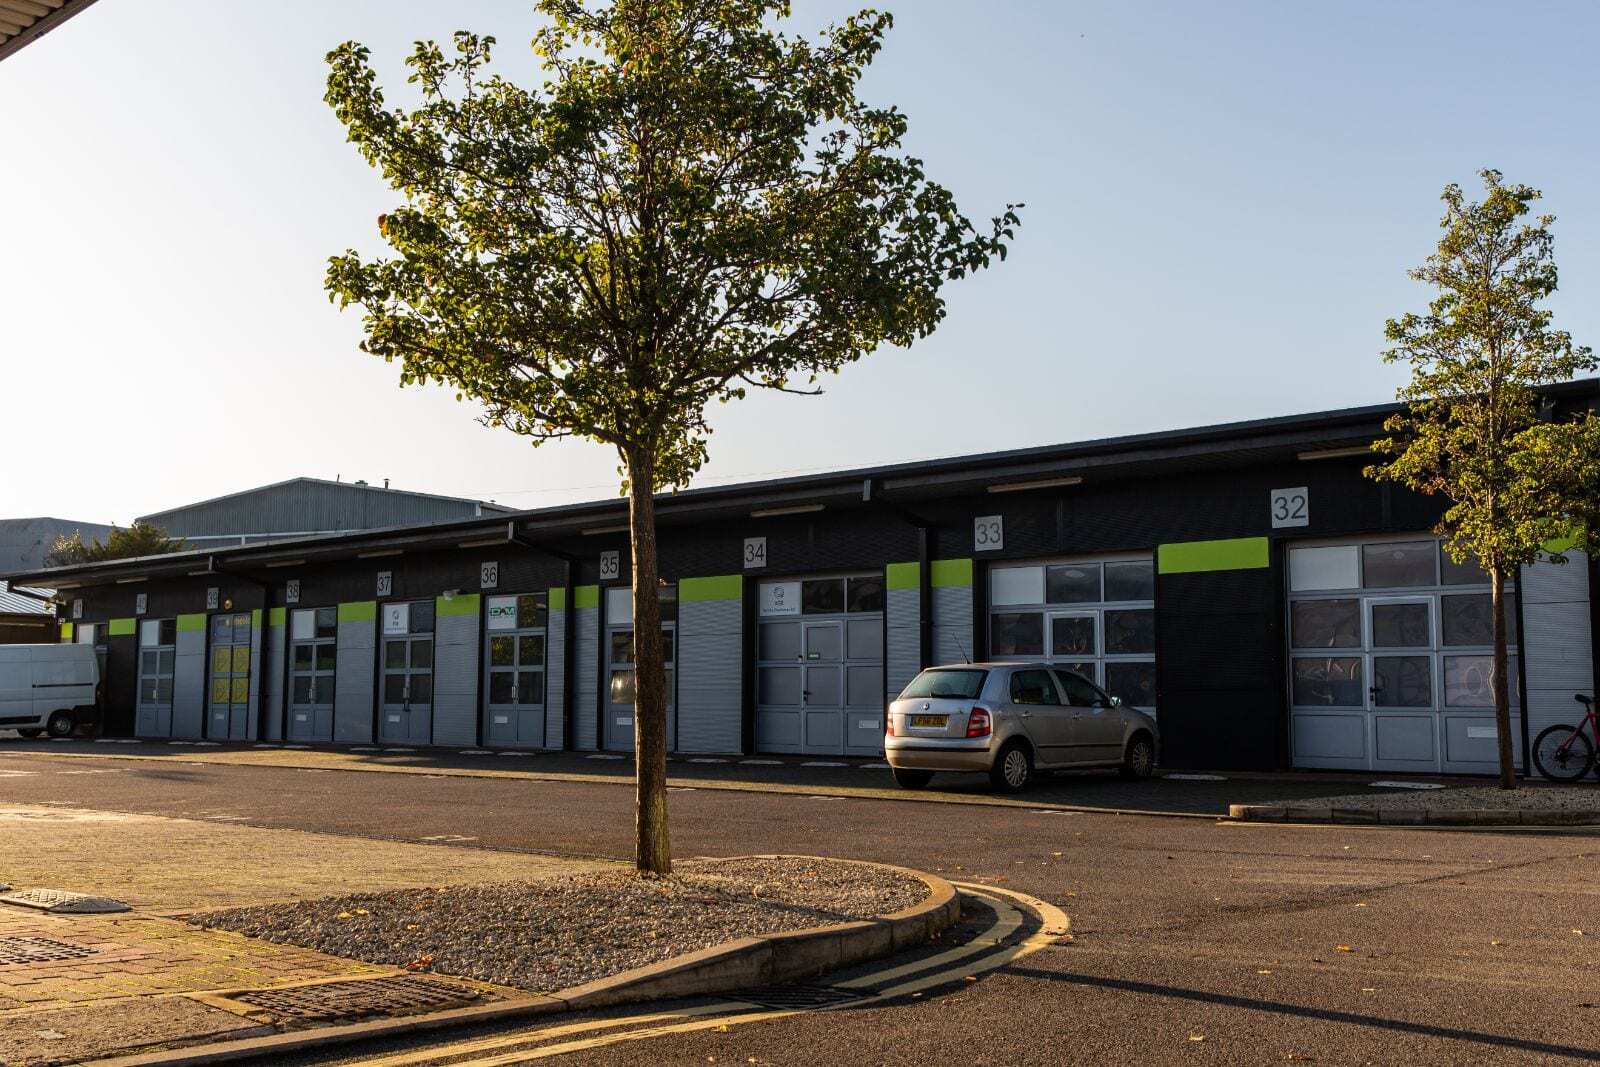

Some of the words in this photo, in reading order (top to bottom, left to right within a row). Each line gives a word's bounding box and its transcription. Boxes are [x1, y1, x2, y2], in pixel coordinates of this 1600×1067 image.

[1275, 495, 1306, 520] 32
[977, 523, 1001, 544] 33
[745, 544, 764, 562] 34
[602, 557, 618, 574] 35
[378, 576, 391, 592] 37
[482, 567, 496, 584] 36
[208, 592, 217, 605] 39
[288, 584, 298, 599] 38
